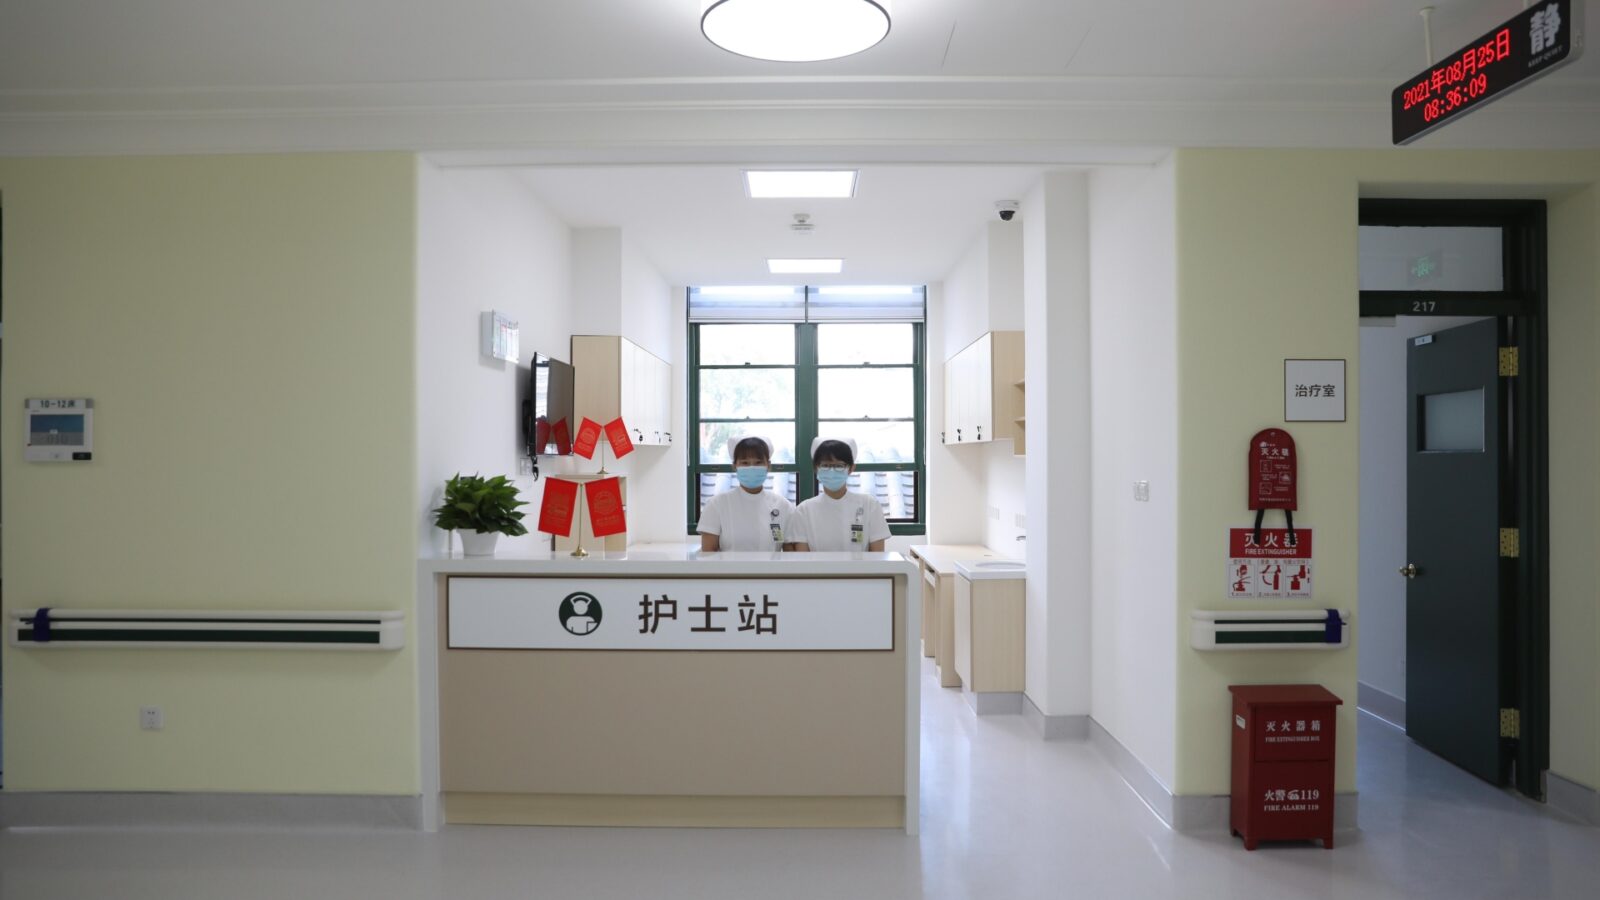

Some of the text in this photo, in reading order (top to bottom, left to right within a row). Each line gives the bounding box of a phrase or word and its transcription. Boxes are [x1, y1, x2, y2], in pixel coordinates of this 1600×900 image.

[1529, 3, 1561, 54] 静
[1403, 28, 1510, 110] 2021年08月25日
[1424, 73, 1487, 122] 08:36:09
[1412, 301, 1436, 312] 217
[1295, 384, 1336, 398] 治疗室
[638, 594, 779, 635] 护士站
[1266, 720, 1320, 732] 灭火器箱
[1264, 789, 1319, 801] 火警 119
